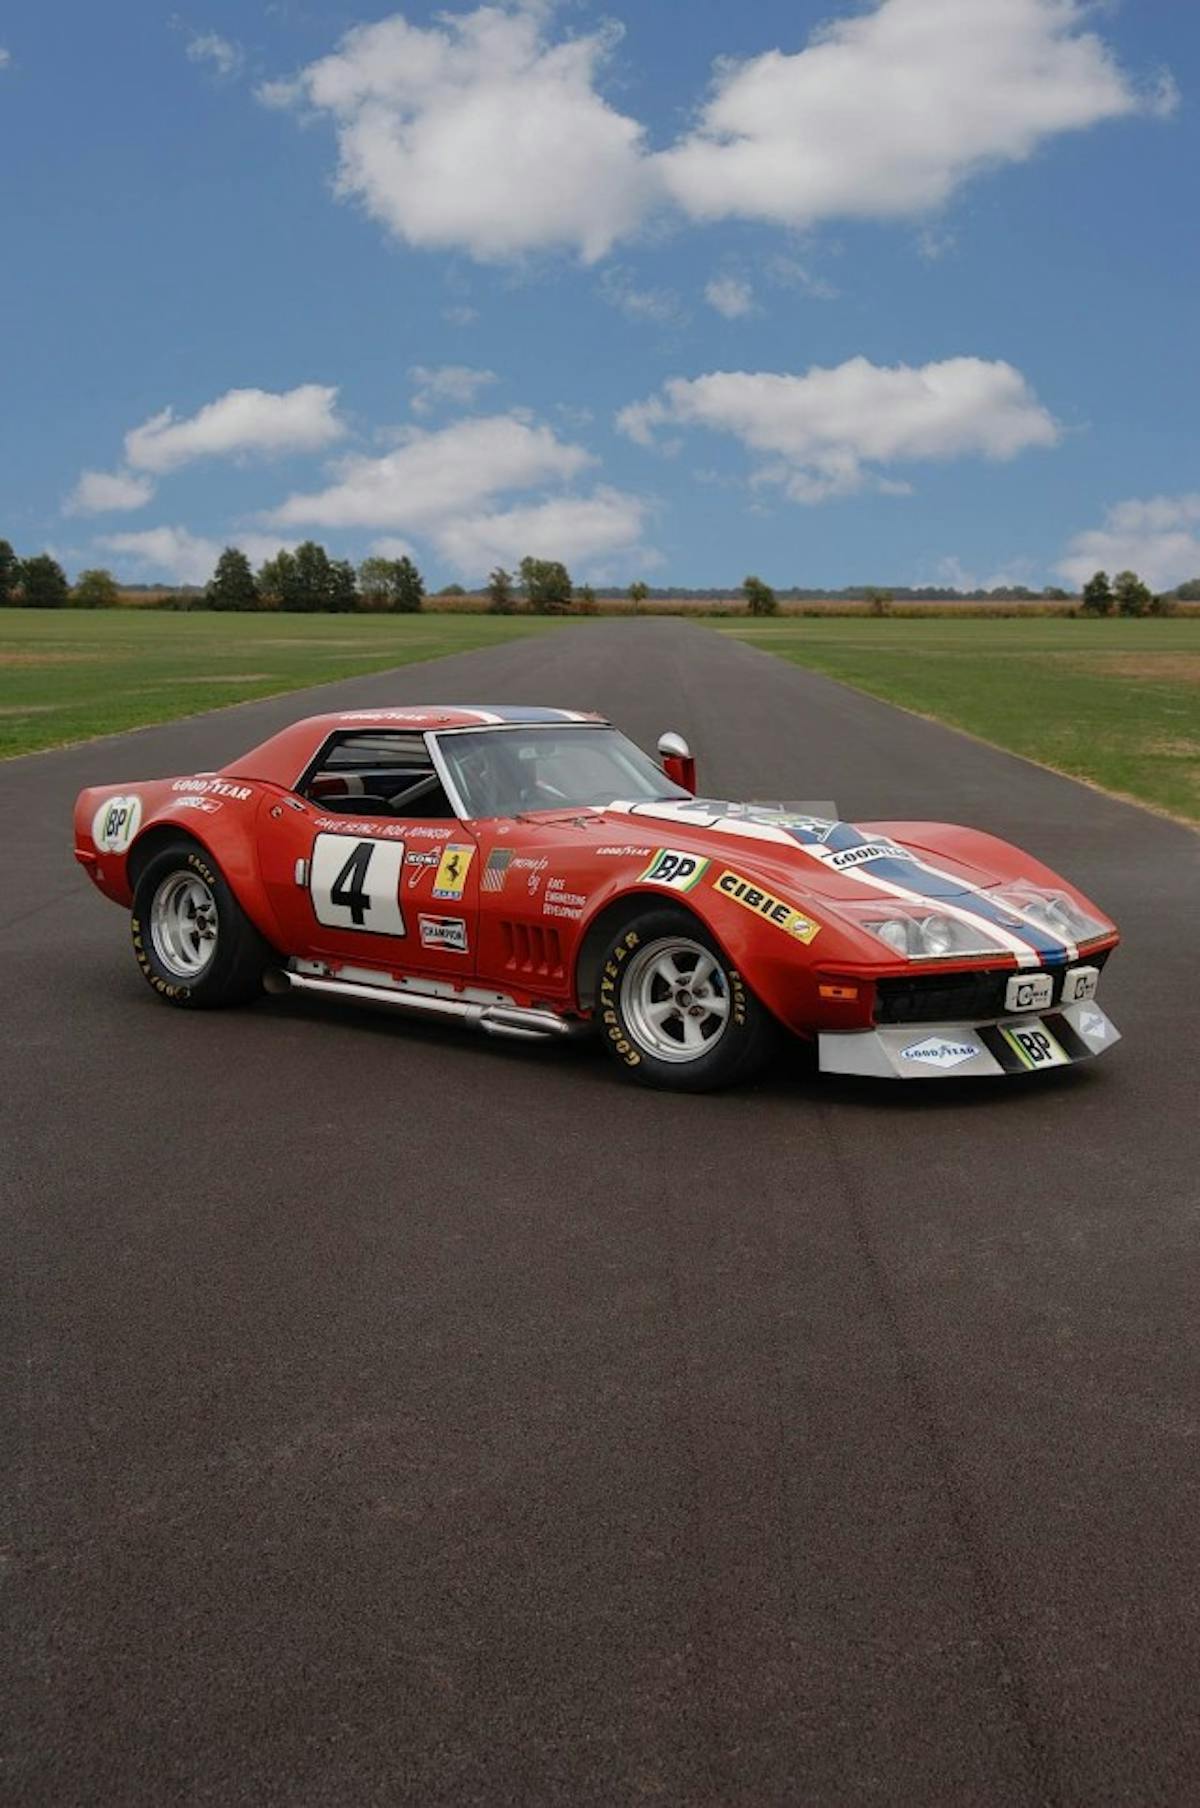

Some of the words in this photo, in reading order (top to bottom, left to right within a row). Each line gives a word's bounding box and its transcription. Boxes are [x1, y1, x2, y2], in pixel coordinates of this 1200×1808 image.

[172, 778, 252, 801] GOODYEAR
[106, 809, 127, 836] BP
[649, 854, 696, 882] BP
[331, 842, 375, 925] 4
[719, 875, 791, 924] CIBIE
[422, 926, 462, 940] CHAMPION
[600, 931, 641, 1067] GOODYEAR
[904, 1044, 976, 1060] GOODYEAR
[1016, 1031, 1053, 1061] BP
